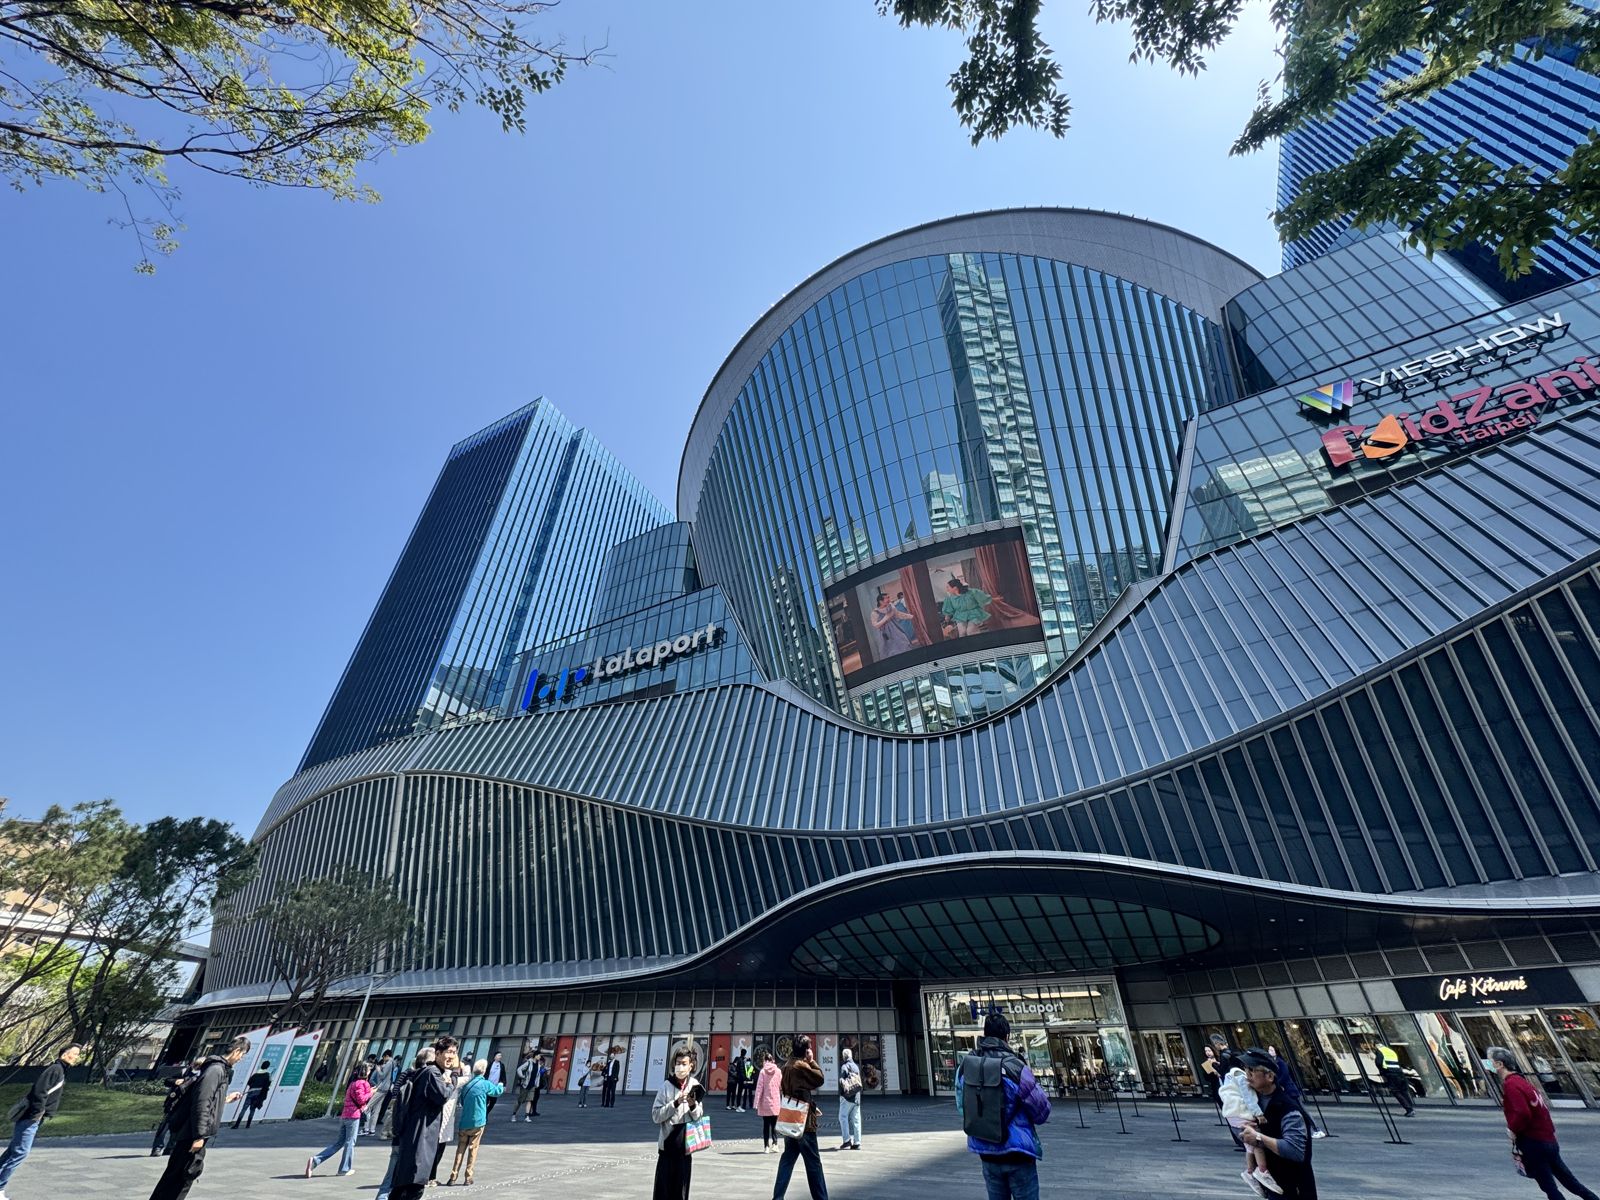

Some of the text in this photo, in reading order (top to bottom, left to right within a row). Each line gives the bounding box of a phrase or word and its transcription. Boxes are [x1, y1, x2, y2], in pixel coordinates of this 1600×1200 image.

[1361, 312, 1563, 388] VIESHOW
[1404, 341, 1539, 390] CINEMAS
[1456, 410, 1538, 444] Taipei
[592, 621, 717, 679] LaLaport
[1006, 1000, 1065, 1016] LaLaport
[1439, 978, 1467, 1001] Café
